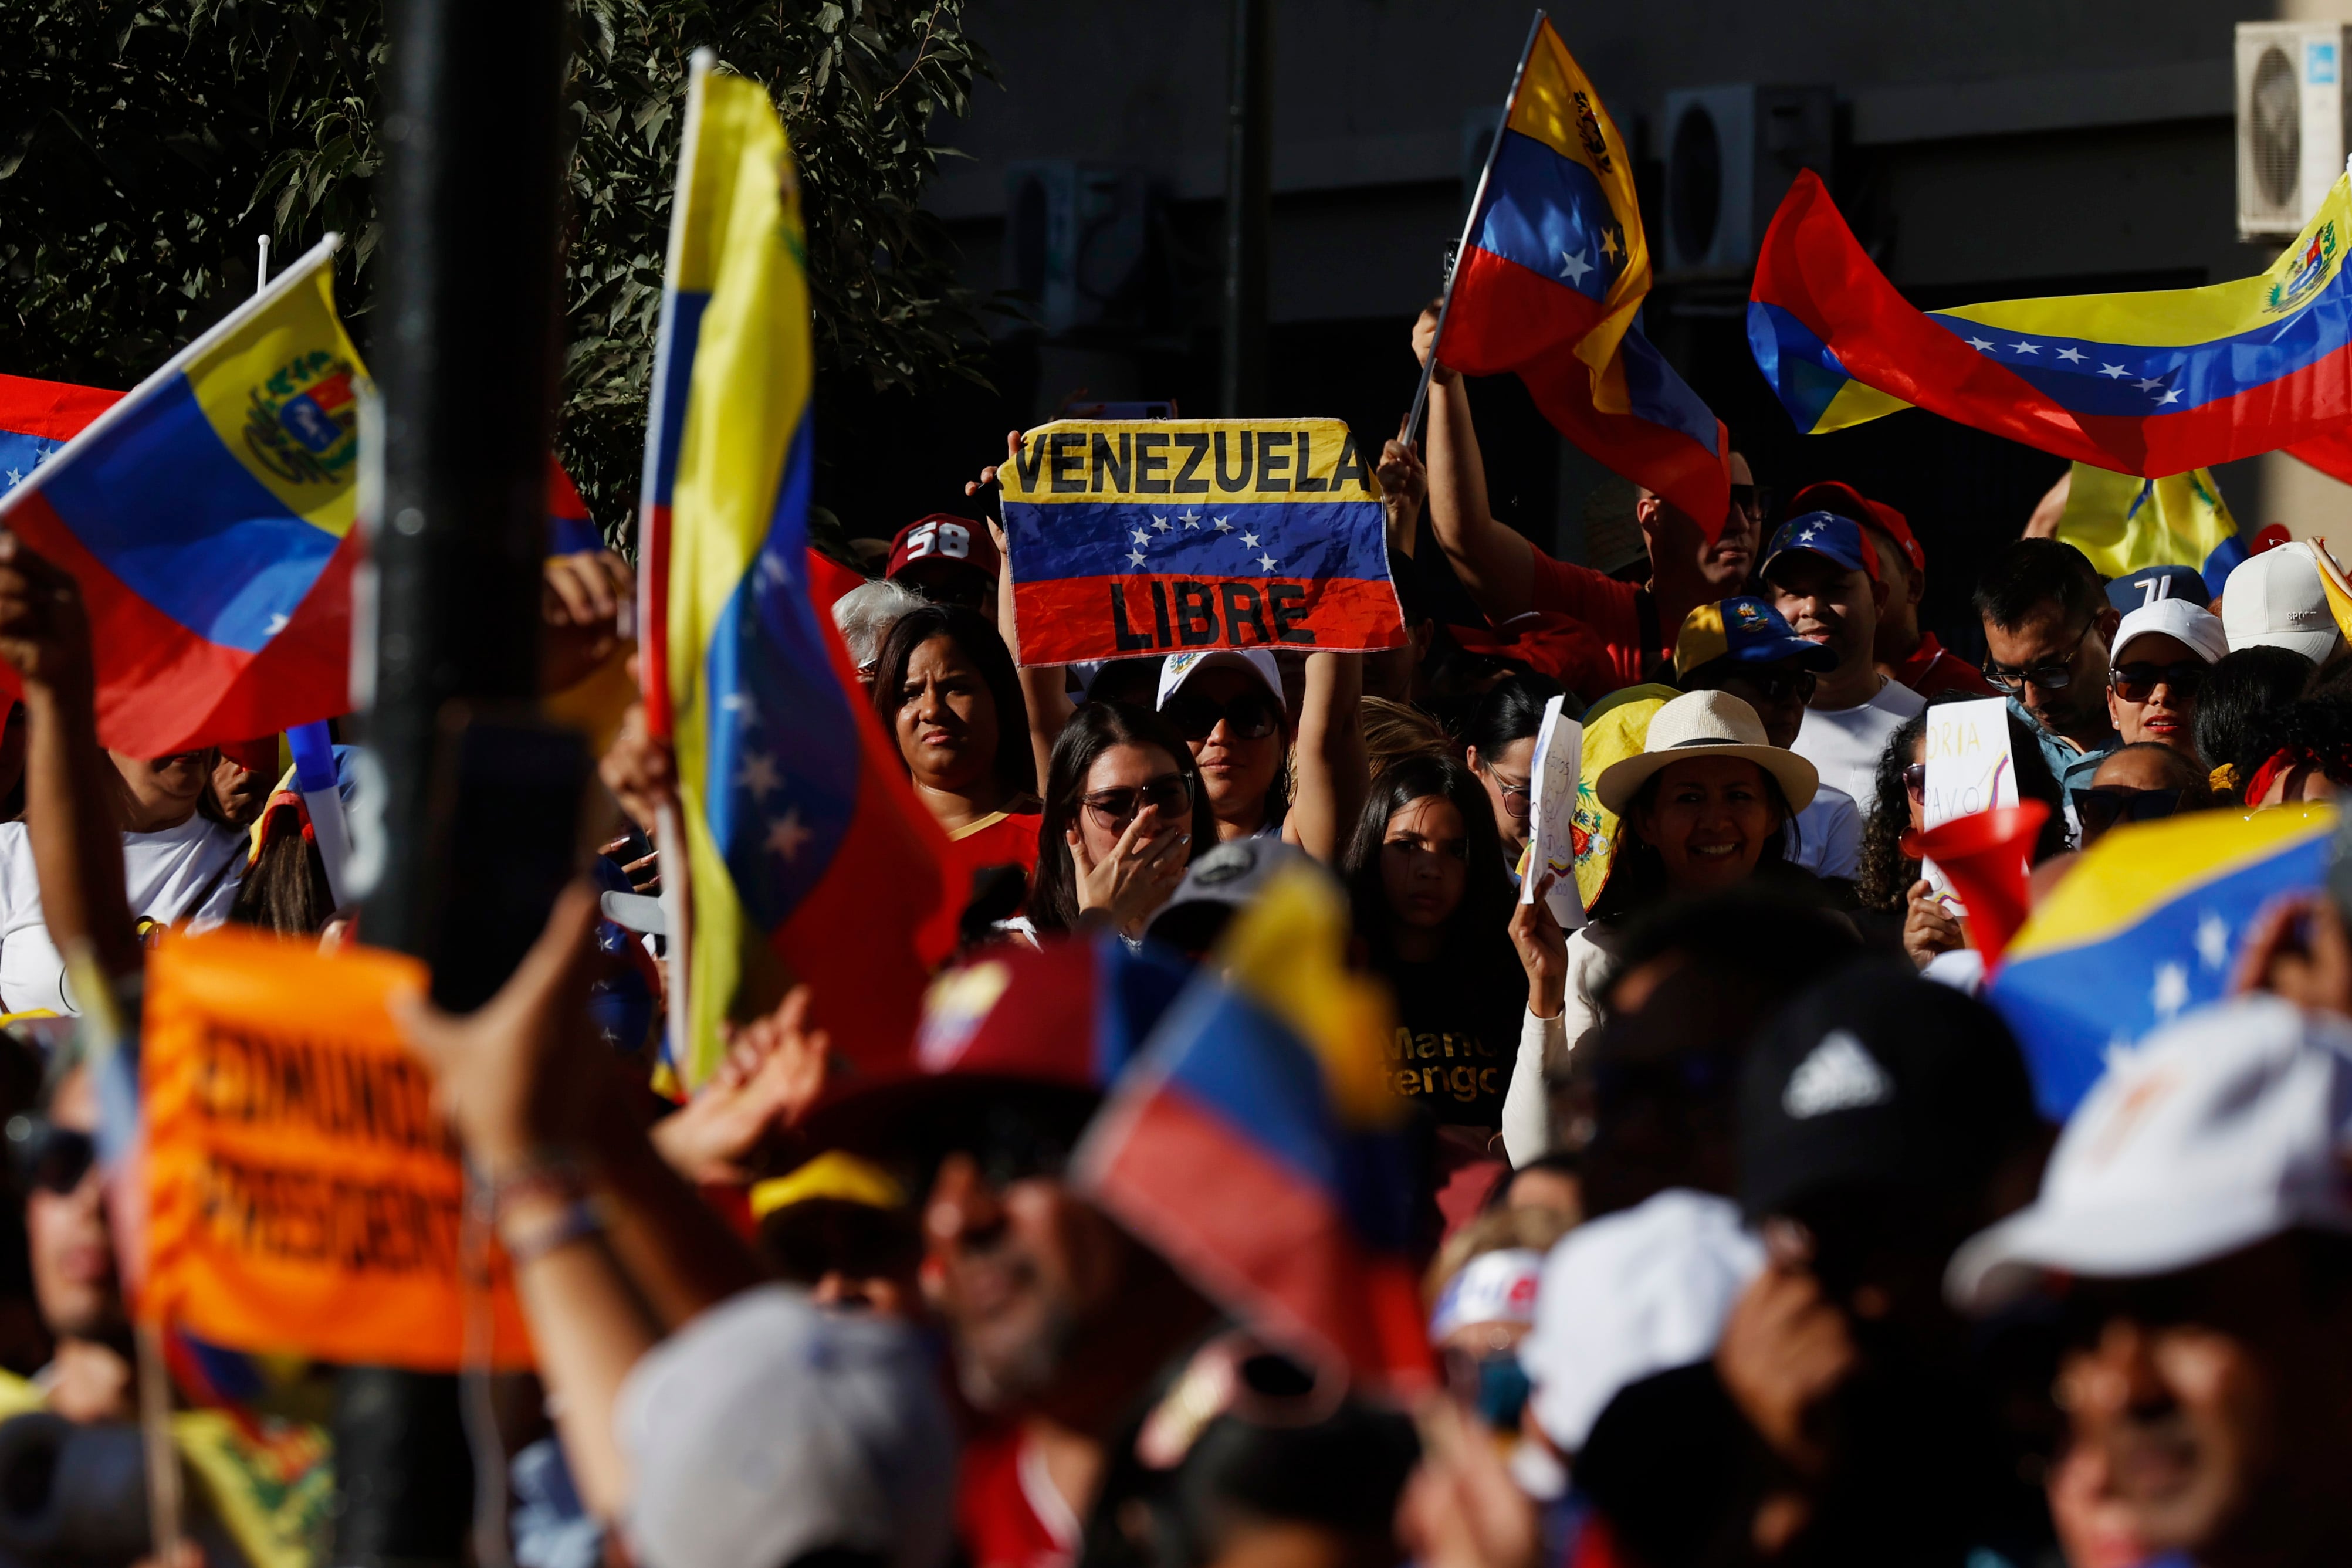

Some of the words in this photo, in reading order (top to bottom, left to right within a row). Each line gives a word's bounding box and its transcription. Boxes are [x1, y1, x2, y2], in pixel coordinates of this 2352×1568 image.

[1016, 431, 1372, 493] VENEZUELA
[907, 521, 970, 561] 58
[1109, 581, 1317, 651] LIBRE
